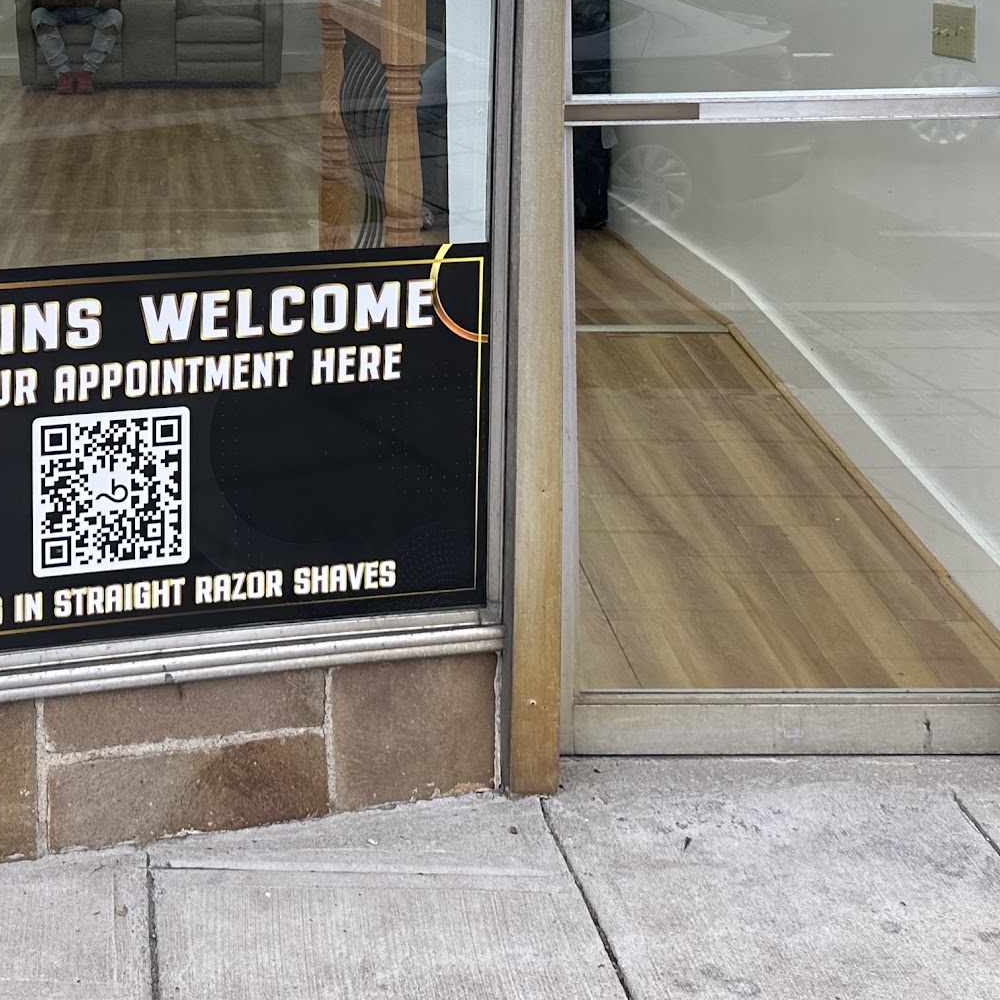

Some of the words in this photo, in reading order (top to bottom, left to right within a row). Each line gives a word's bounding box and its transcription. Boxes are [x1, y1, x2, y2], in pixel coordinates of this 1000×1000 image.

[140, 278, 436, 345] WELCOME
[53, 350, 294, 404] APPOINTMENT
[311, 343, 403, 385] HERE
[14, 591, 43, 623] IN
[53, 577, 186, 618] STRAIGHT
[195, 569, 283, 605] RAZOR
[293, 560, 396, 595] SHAVES
